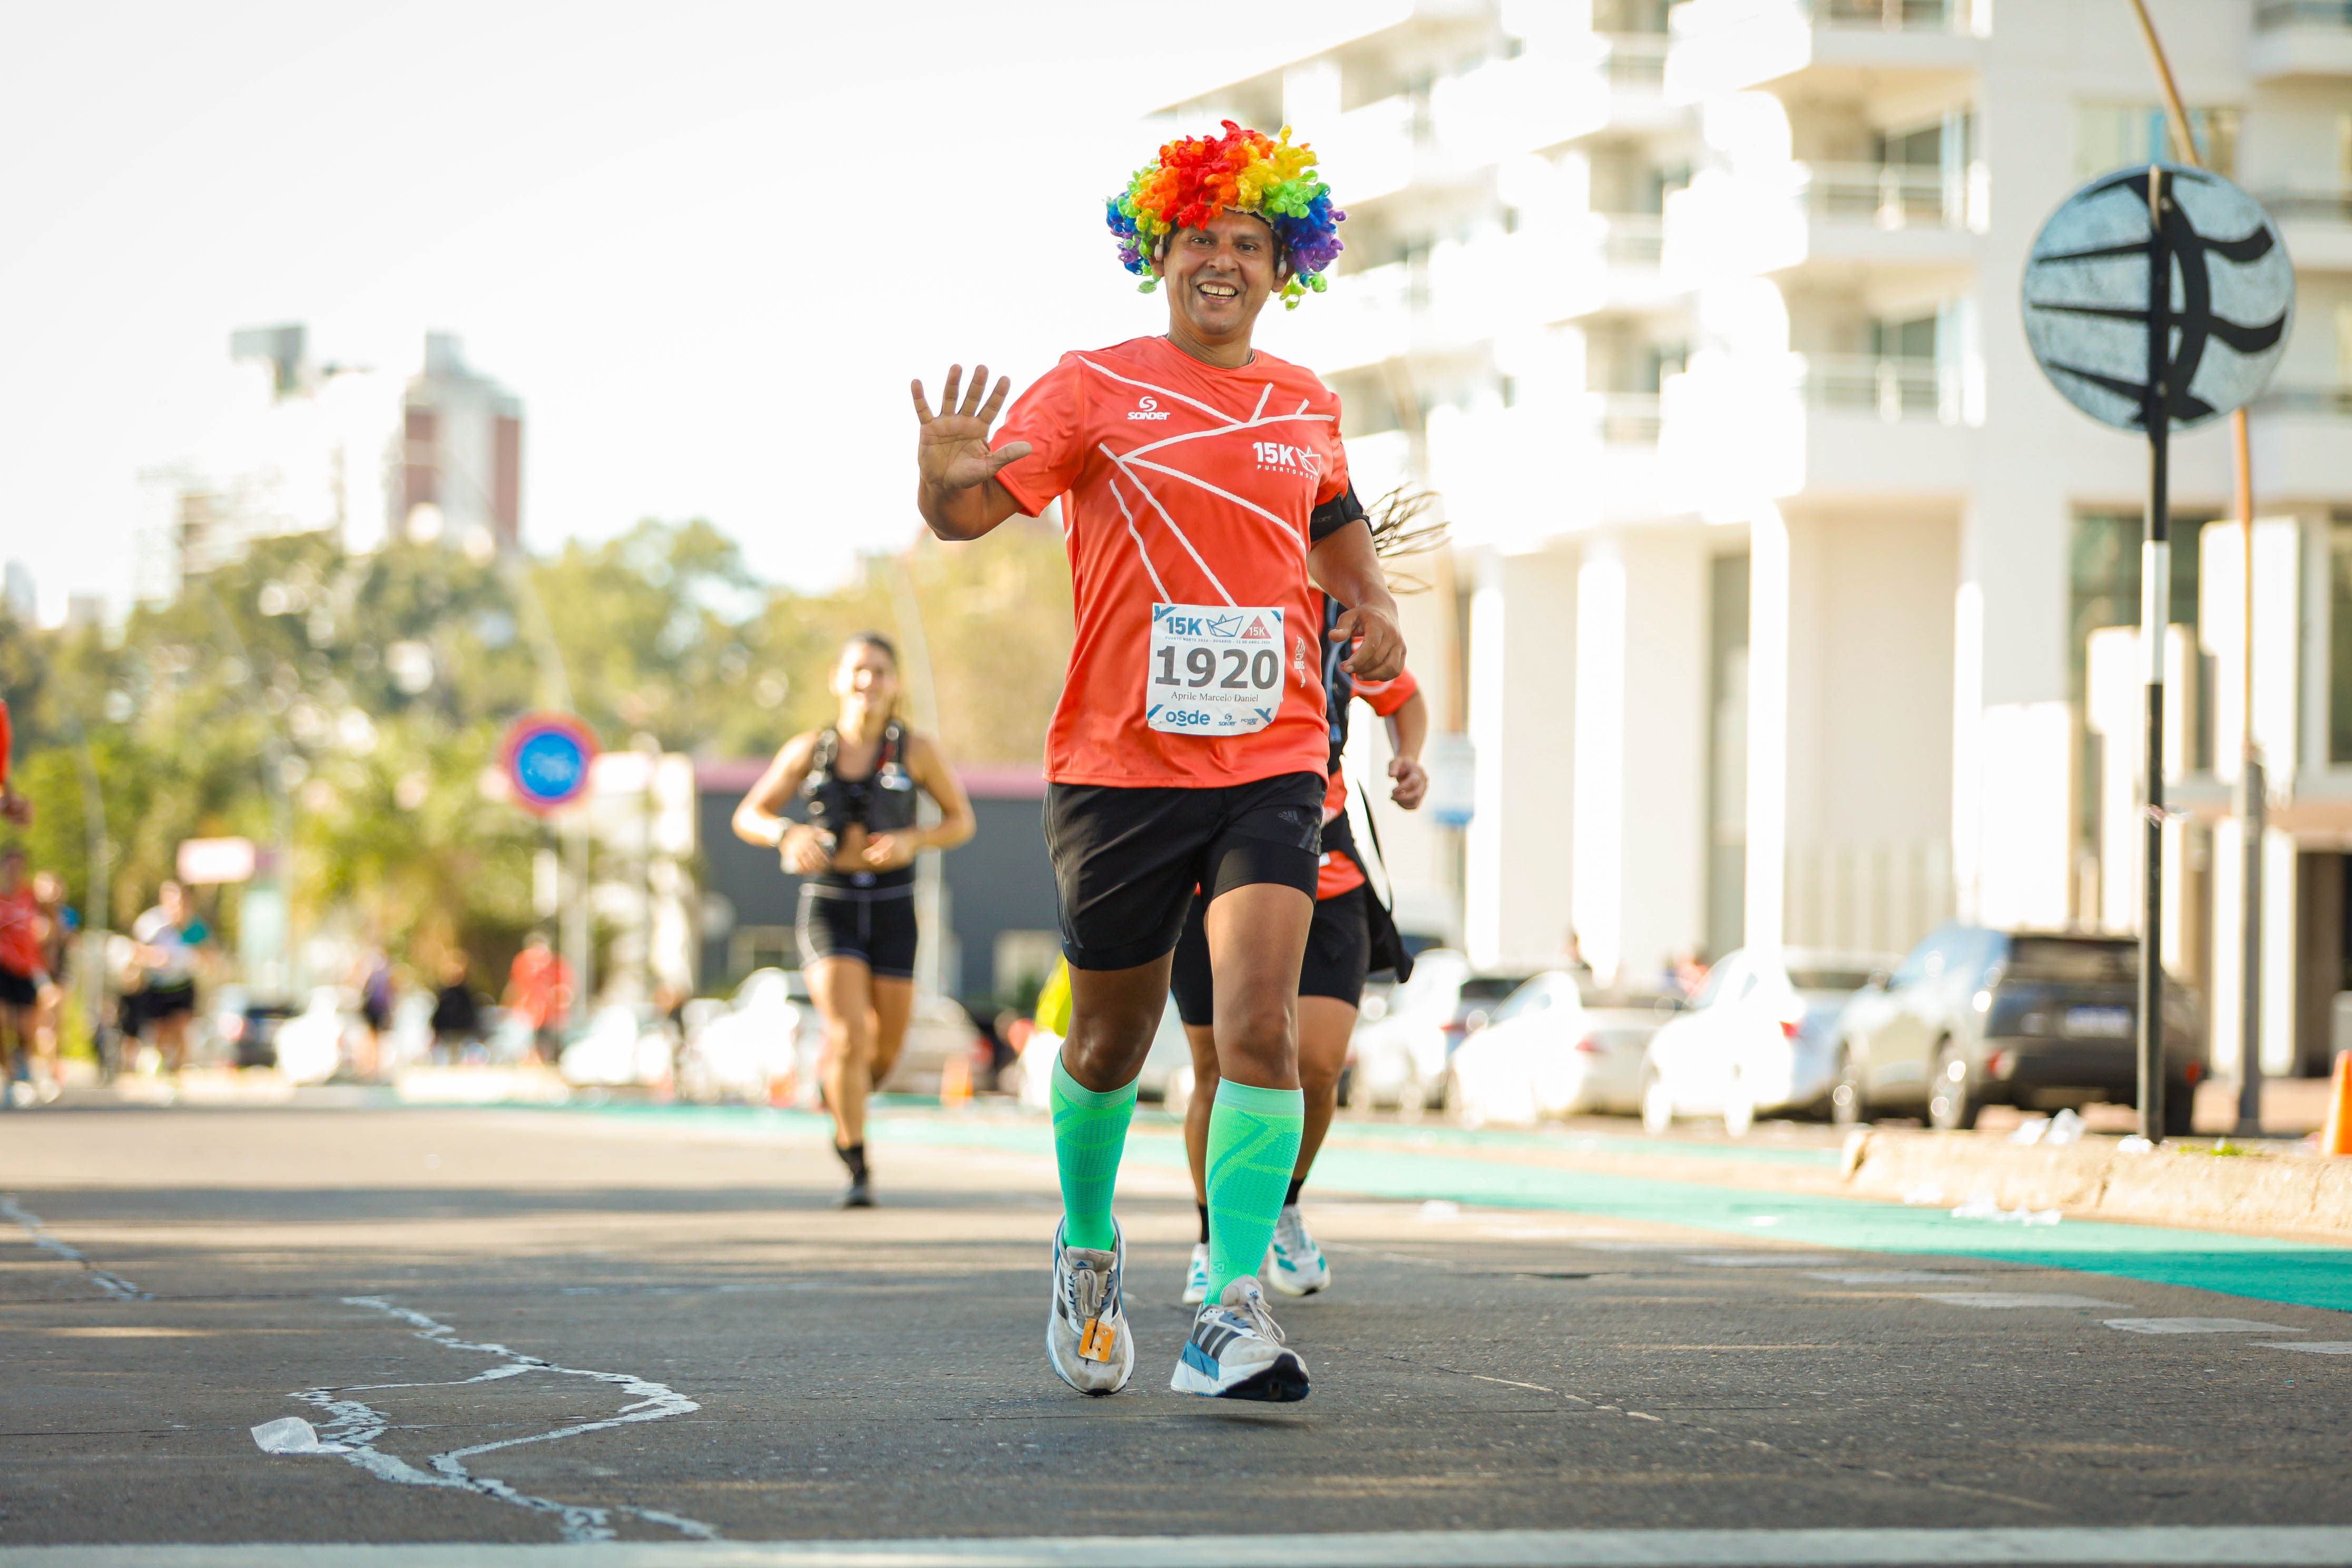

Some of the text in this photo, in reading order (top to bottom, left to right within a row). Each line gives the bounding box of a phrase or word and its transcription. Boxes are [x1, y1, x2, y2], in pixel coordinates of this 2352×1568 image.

[1252, 442, 1296, 467] 15K
[1257, 464, 1296, 474] PUERTO
[1166, 616, 1203, 636] 15K
[1249, 626, 1265, 636] 15K
[1155, 645, 1279, 689] 1920
[1171, 691, 1197, 701] Aprile
[1199, 693, 1232, 701] Marcelo
[1165, 710, 1210, 726] osde
